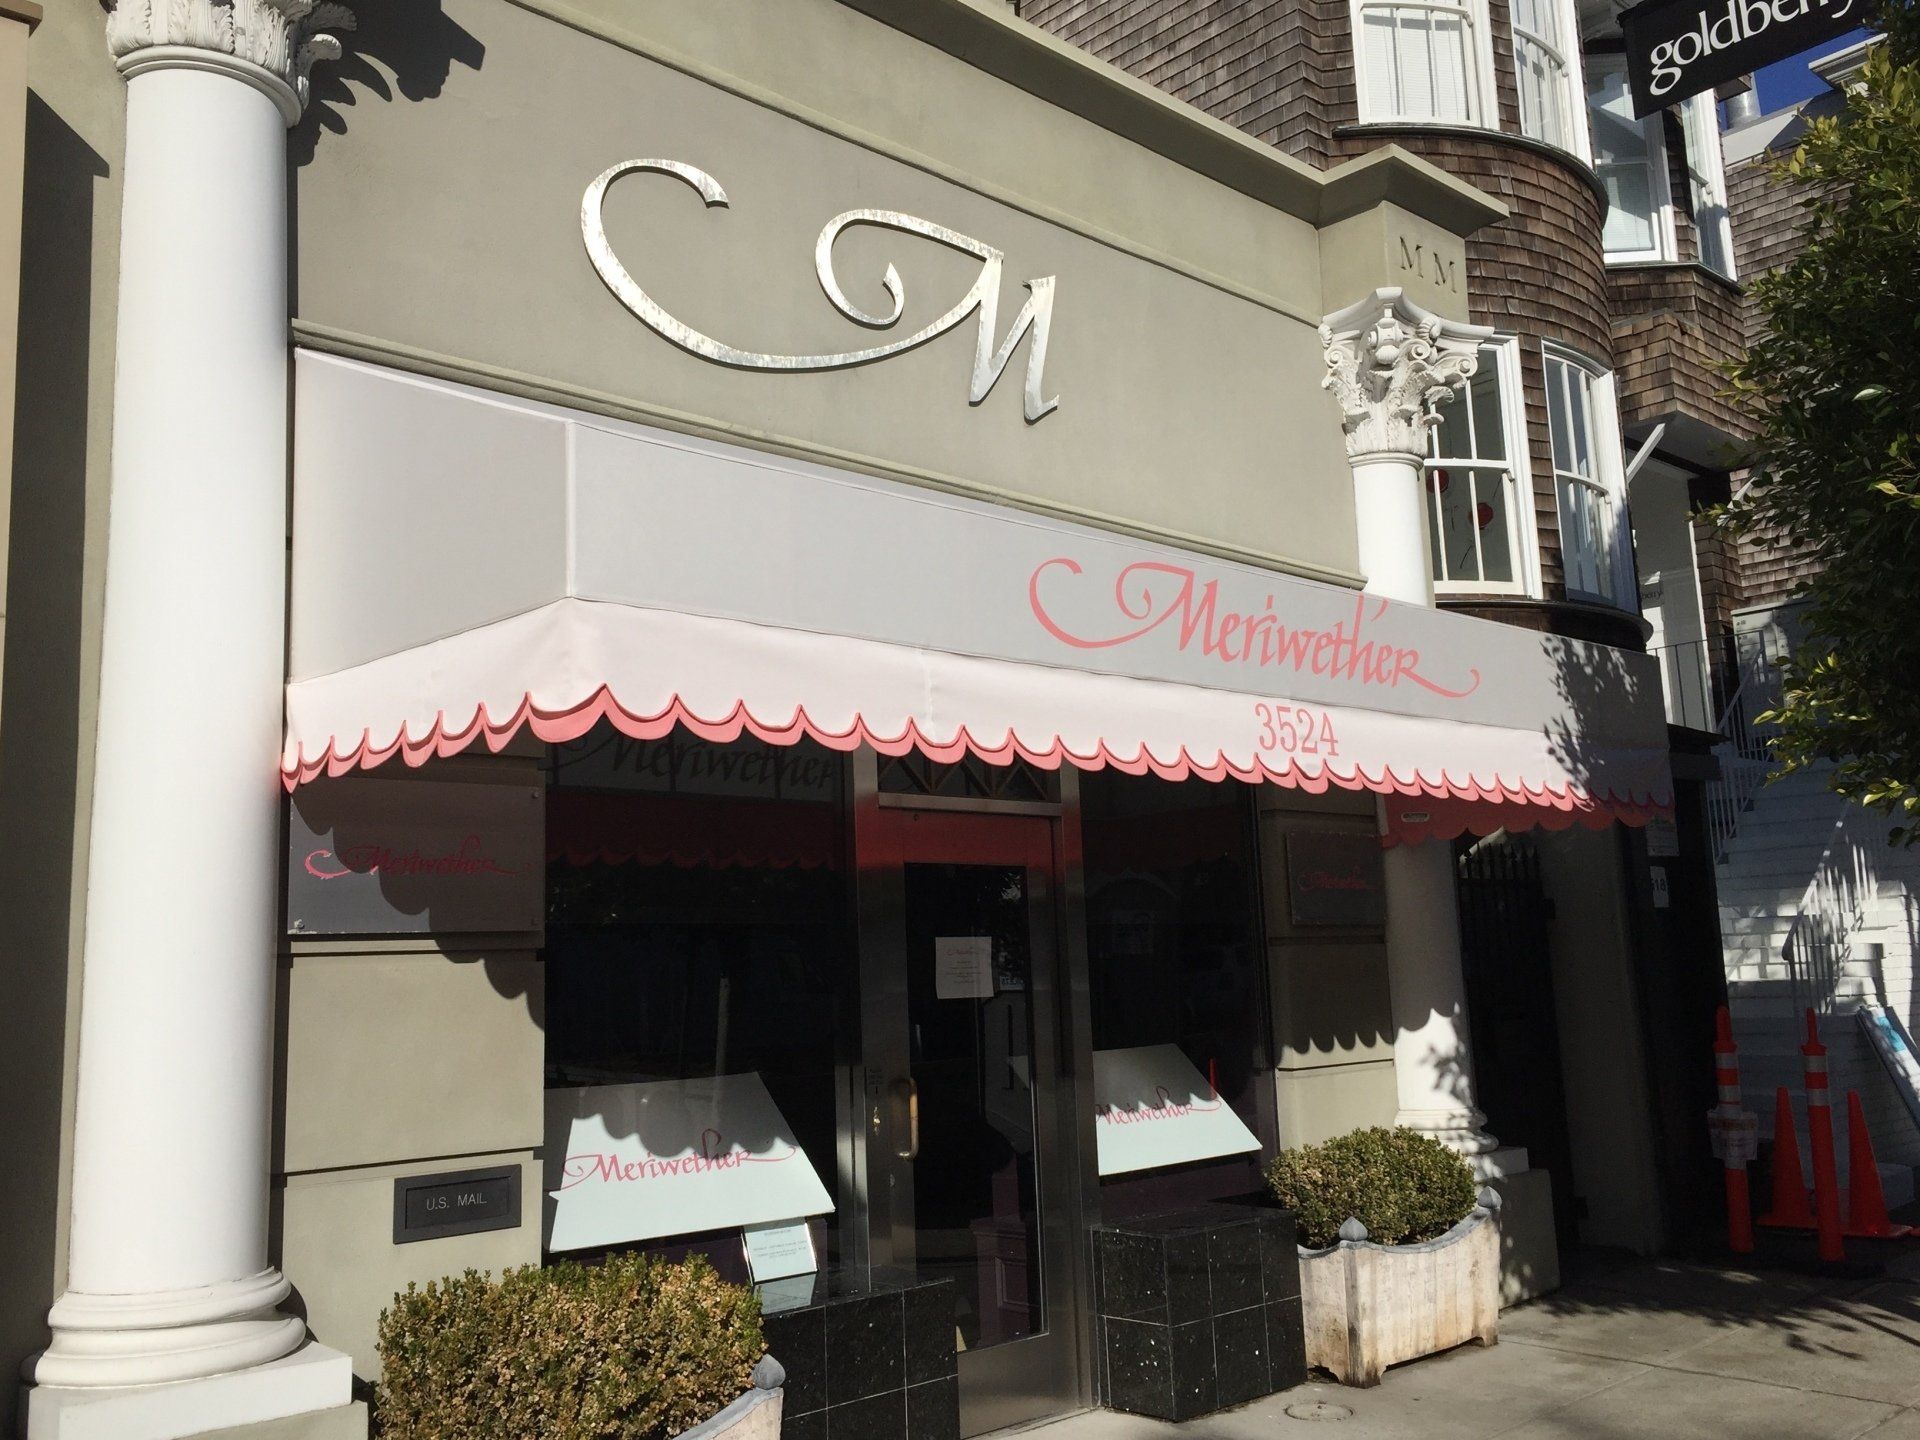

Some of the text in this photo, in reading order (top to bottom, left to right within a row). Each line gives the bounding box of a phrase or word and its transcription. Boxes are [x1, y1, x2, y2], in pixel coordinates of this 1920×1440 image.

[1649, 0, 1853, 97] goldbe
[1029, 556, 1481, 698] Meriwether
[1254, 702, 1340, 757] 3524
[544, 1128, 796, 1193] Meriwether
[426, 1192, 488, 1211] U.S. MAIL
